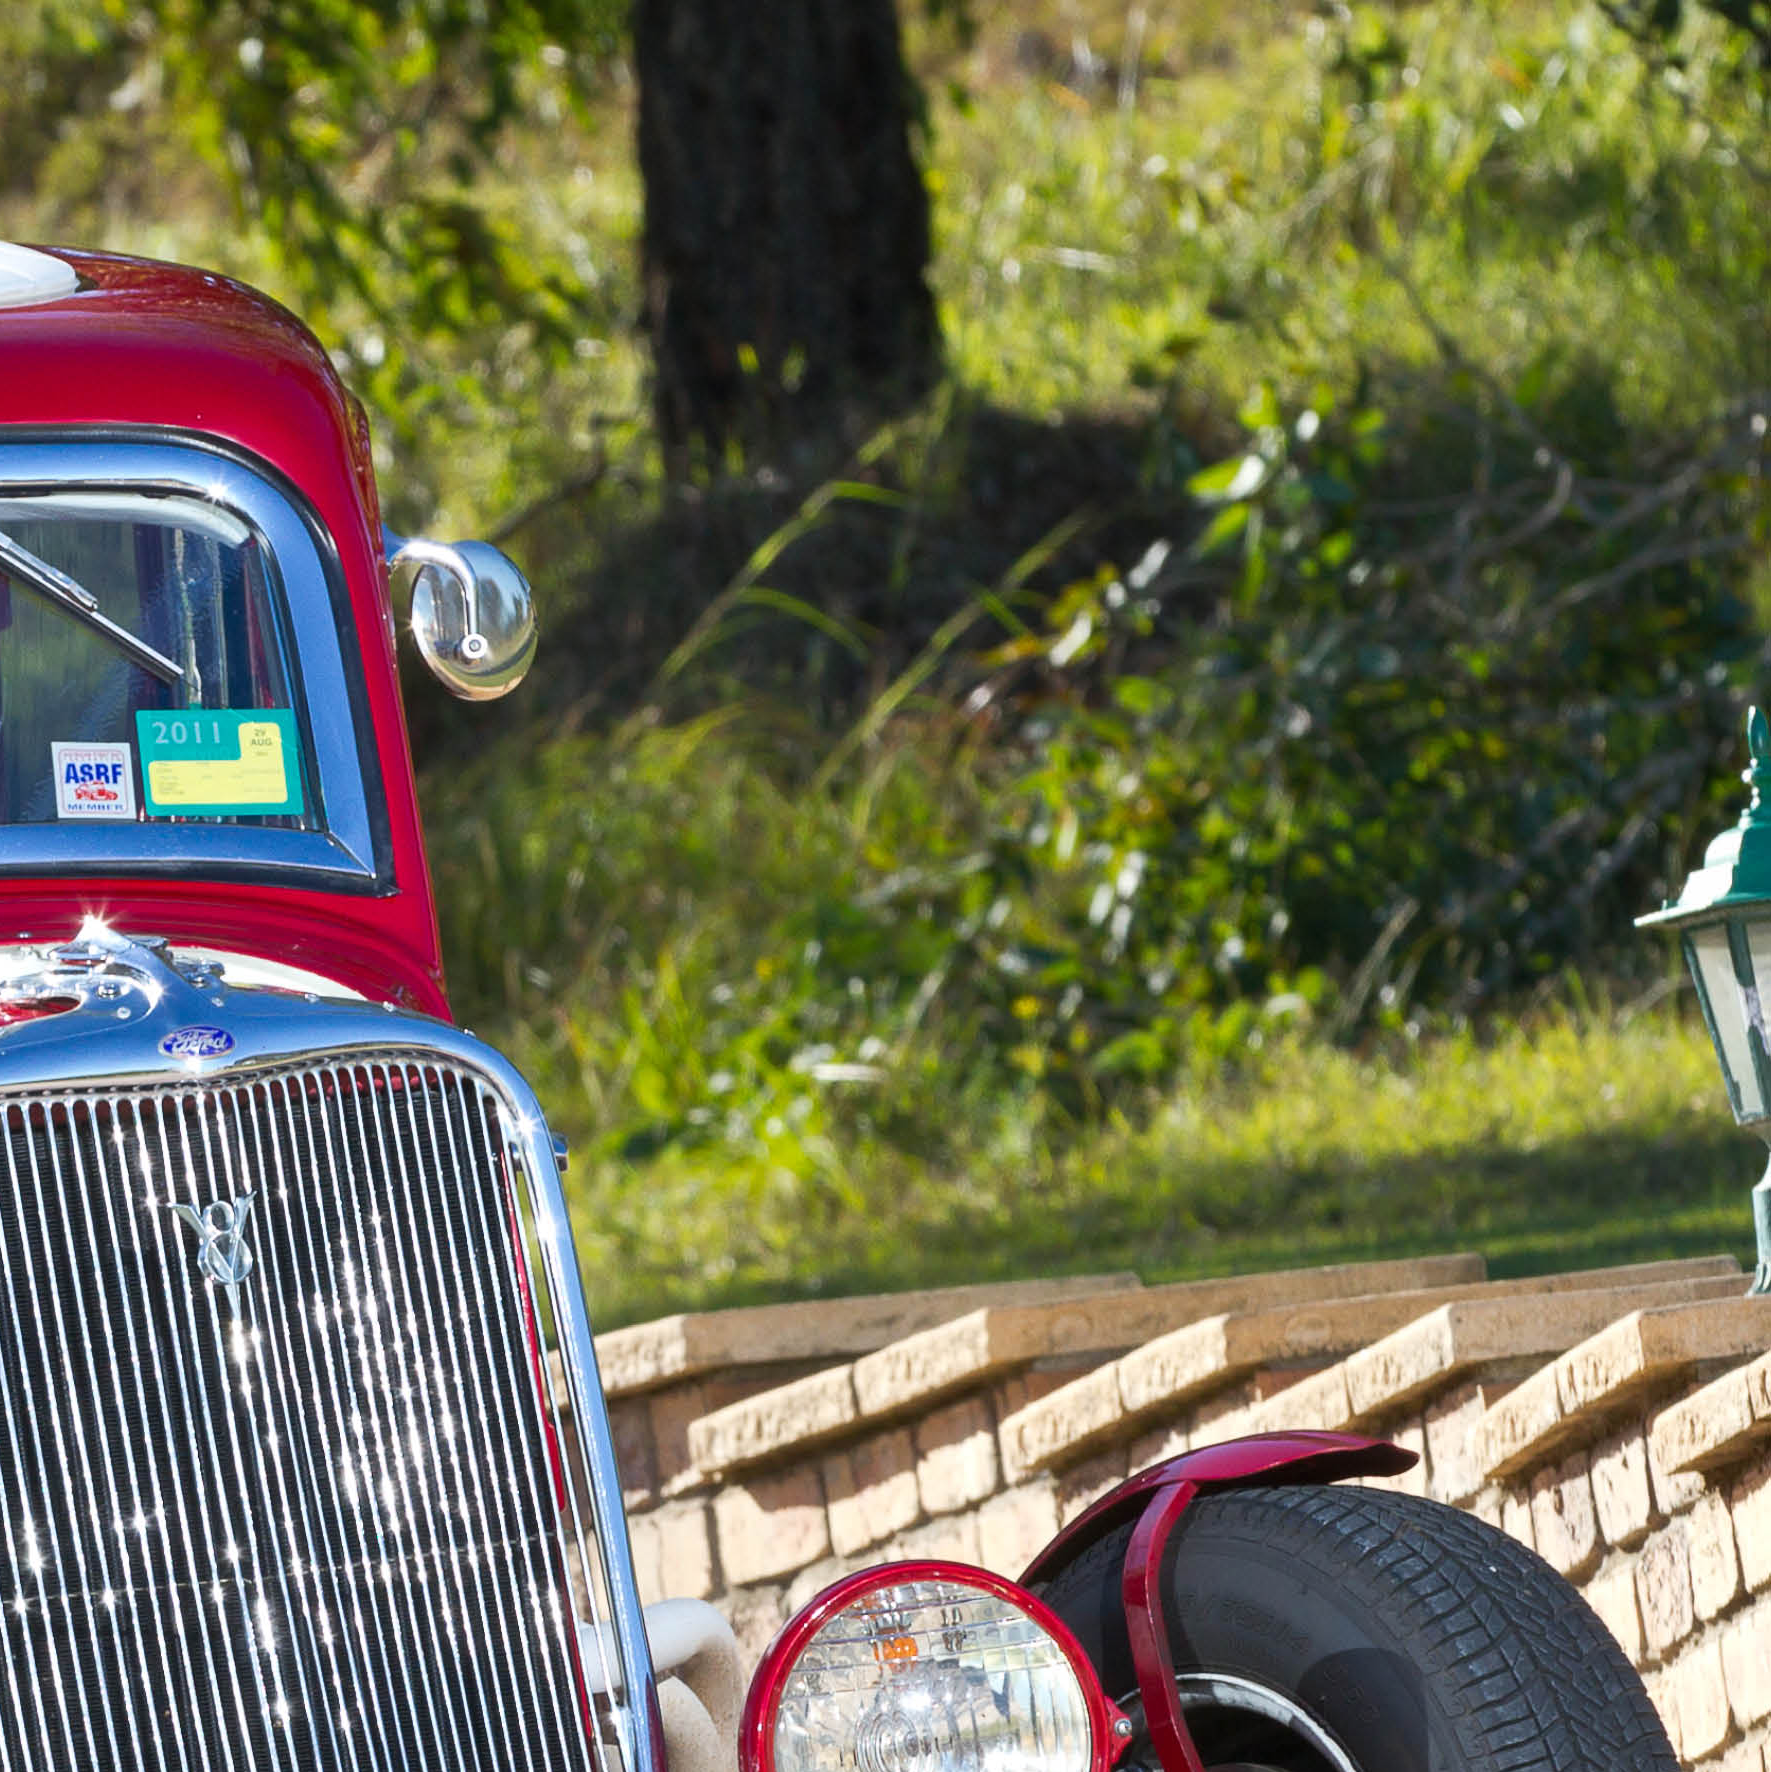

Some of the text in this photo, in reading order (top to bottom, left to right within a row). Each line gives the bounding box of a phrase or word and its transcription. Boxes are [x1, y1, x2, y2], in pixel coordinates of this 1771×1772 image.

[151, 721, 221, 744] 2011
[250, 737, 273, 746] AUG
[65, 763, 122, 784] ASRF
[67, 802, 124, 811] MEMBER
[170, 1028, 228, 1057] Ford
